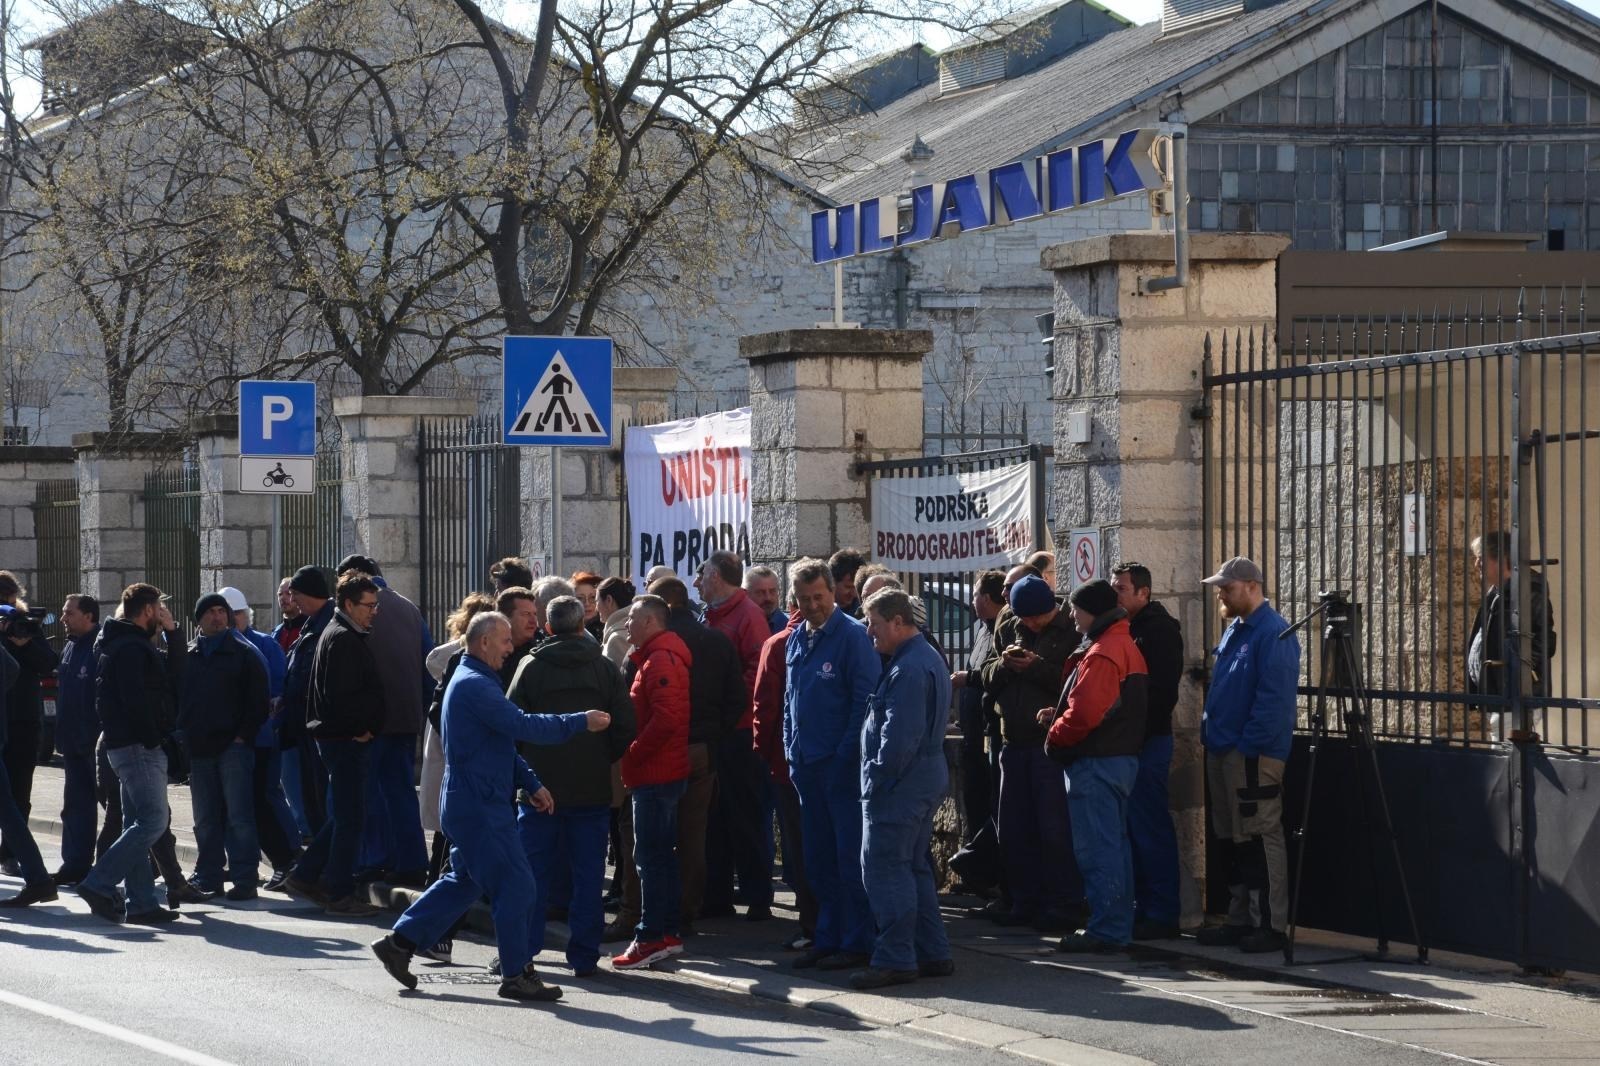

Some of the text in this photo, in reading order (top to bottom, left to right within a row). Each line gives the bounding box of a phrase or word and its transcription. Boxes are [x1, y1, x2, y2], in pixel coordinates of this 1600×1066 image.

[811, 128, 1148, 264] ULJANIK
[262, 395, 294, 440] P
[661, 435, 748, 506] UNIŠTI,
[914, 488, 989, 523] PODRŠKA
[640, 532, 665, 577] PA
